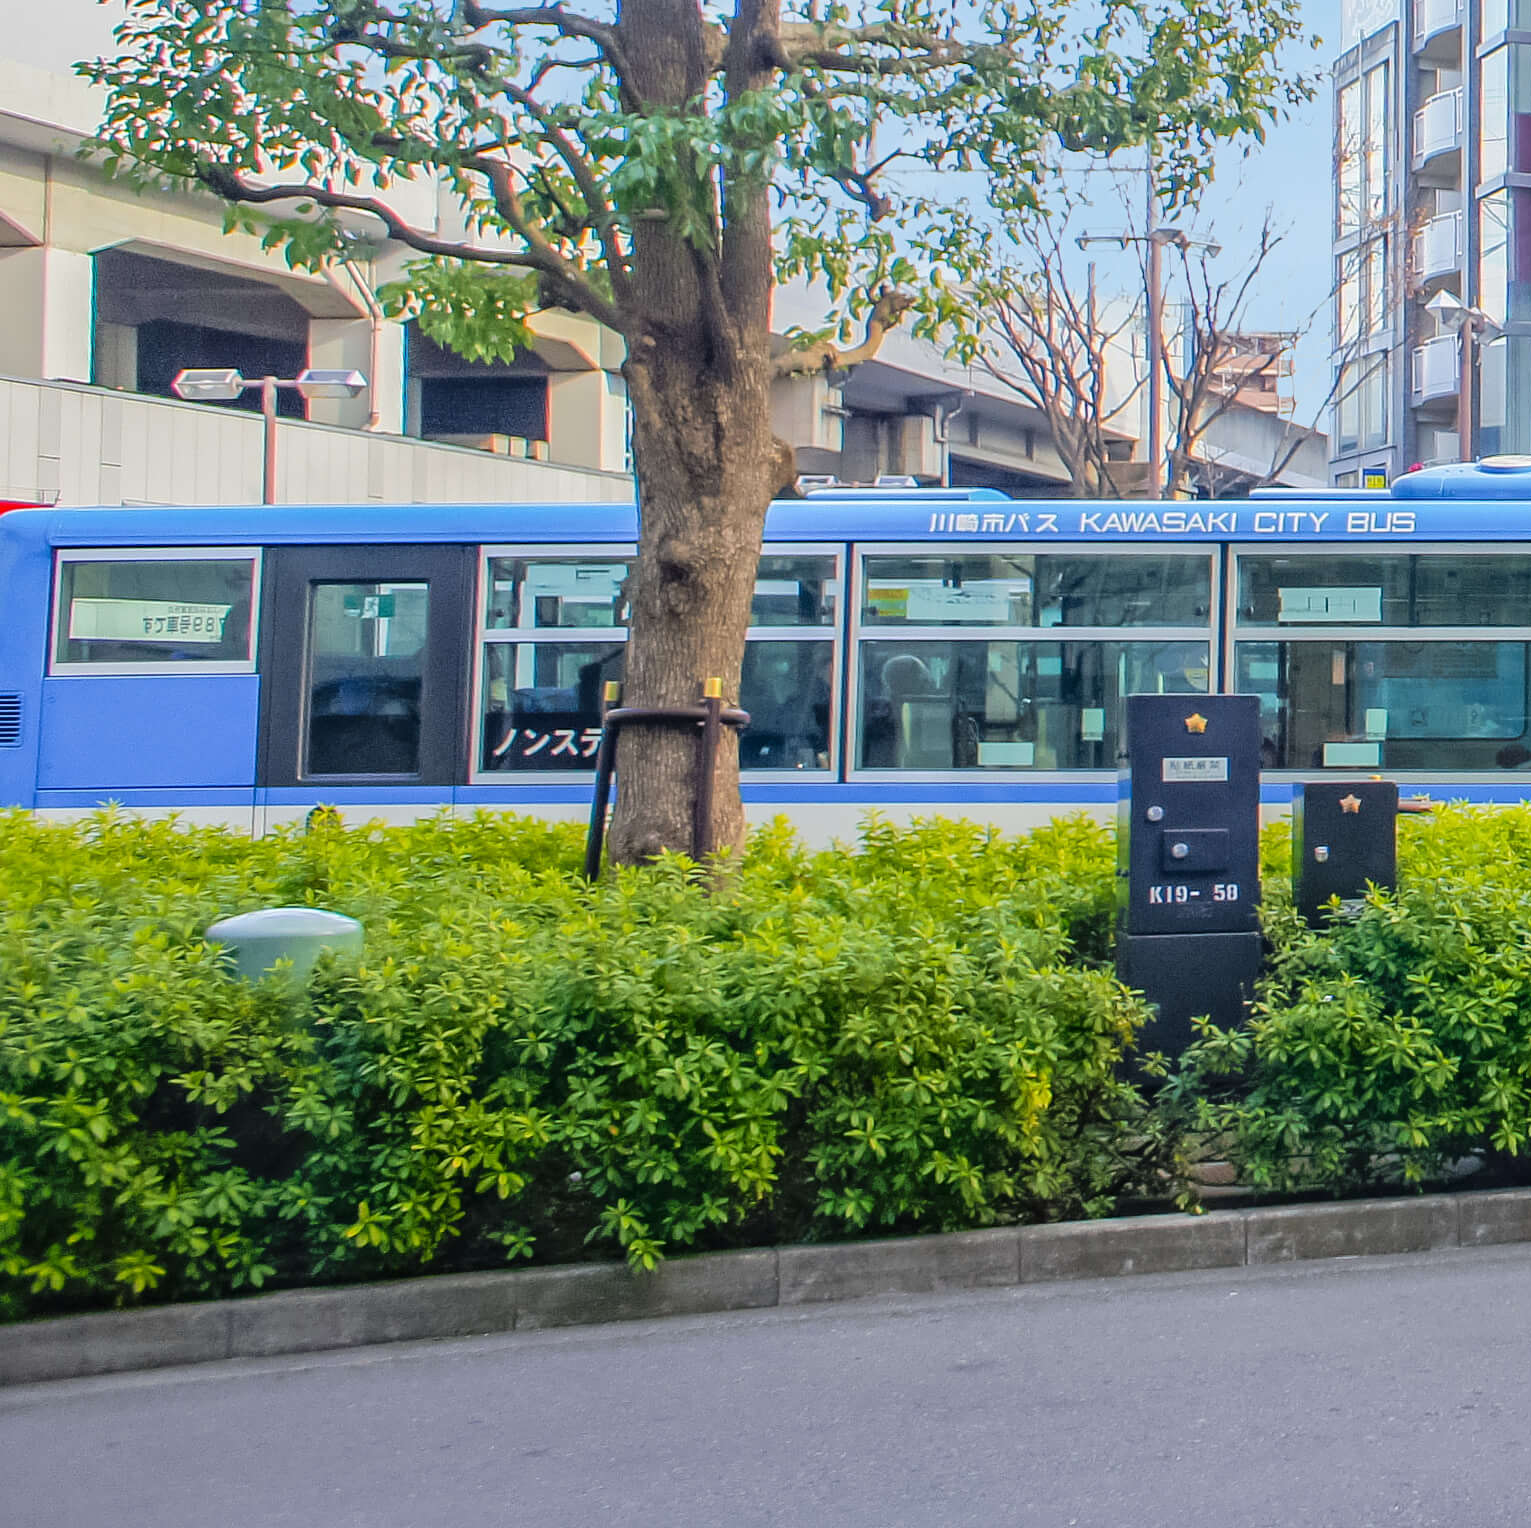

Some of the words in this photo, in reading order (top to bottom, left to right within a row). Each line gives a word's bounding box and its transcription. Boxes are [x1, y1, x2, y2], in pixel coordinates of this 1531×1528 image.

[929, 512, 1059, 534] 川崎市バス
[1080, 512, 1238, 533] KAWASAKI
[1254, 512, 1328, 533] CITY
[1347, 512, 1416, 533] BUS
[1149, 885, 1201, 905] K19-
